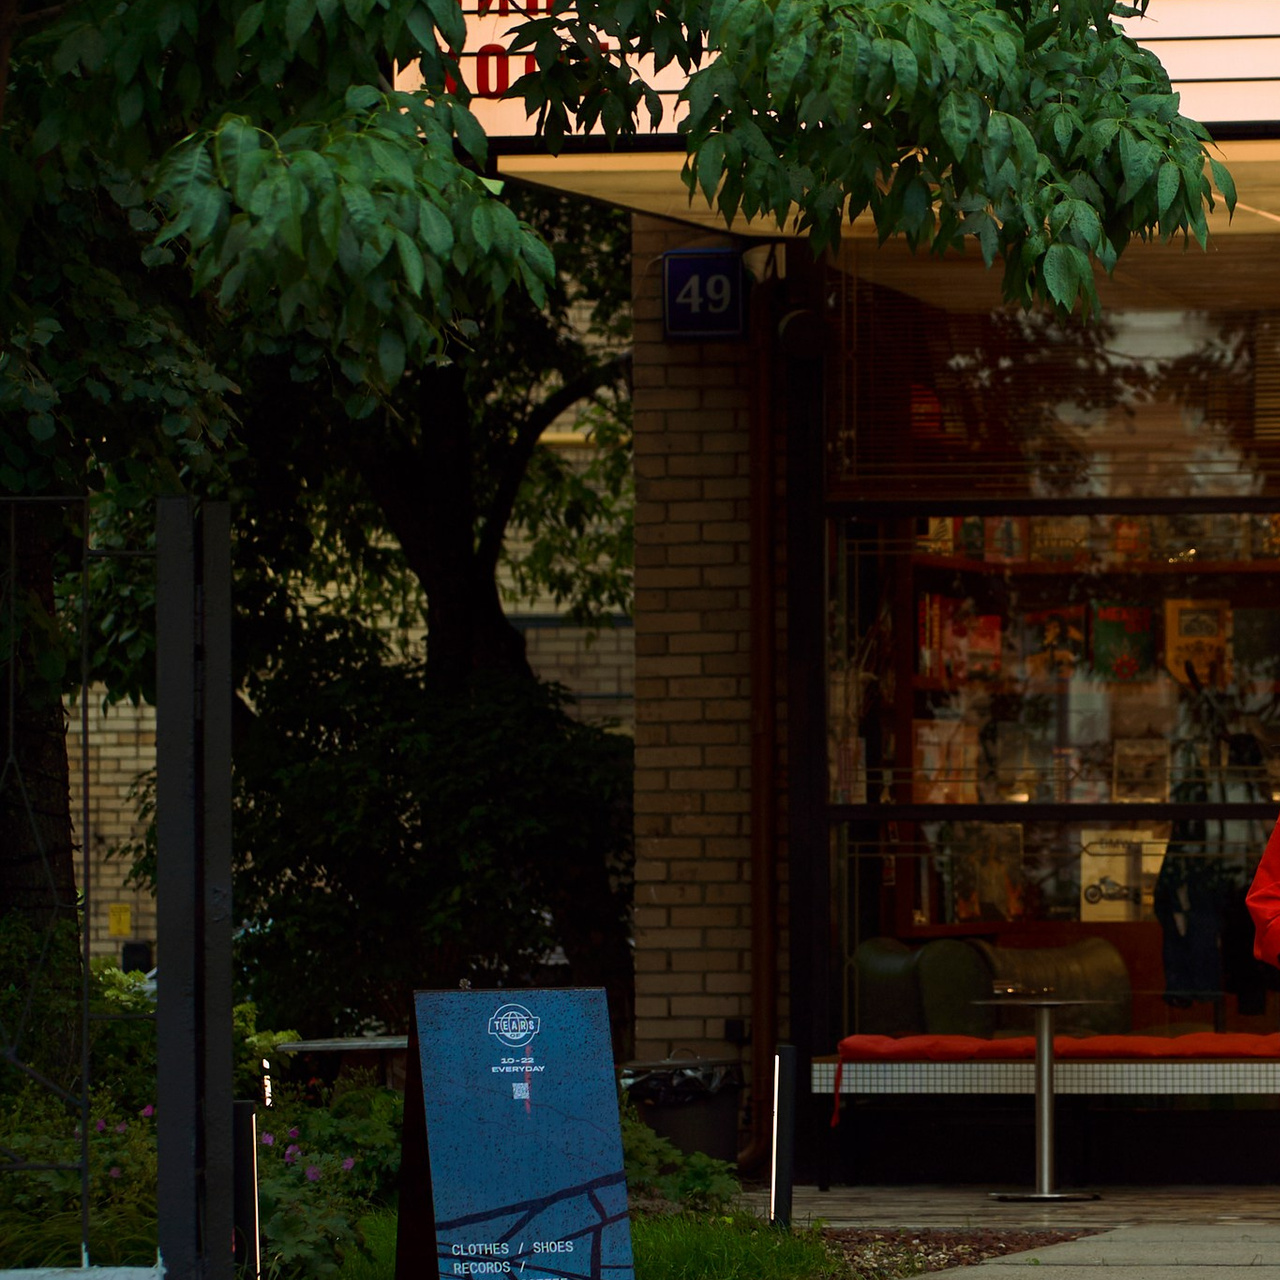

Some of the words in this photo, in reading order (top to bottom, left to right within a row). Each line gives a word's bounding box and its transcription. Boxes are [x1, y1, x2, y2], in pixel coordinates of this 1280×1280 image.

[675, 274, 731, 314] 49
[493, 1020, 535, 1031] TEARS
[491, 1065, 545, 1073] EVERYDAY
[451, 1243, 509, 1256] CLOTHES
[518, 1242, 524, 1255] /
[533, 1241, 574, 1254] SHOES
[453, 1261, 511, 1274] RECORDS
[519, 1260, 526, 1273] /
